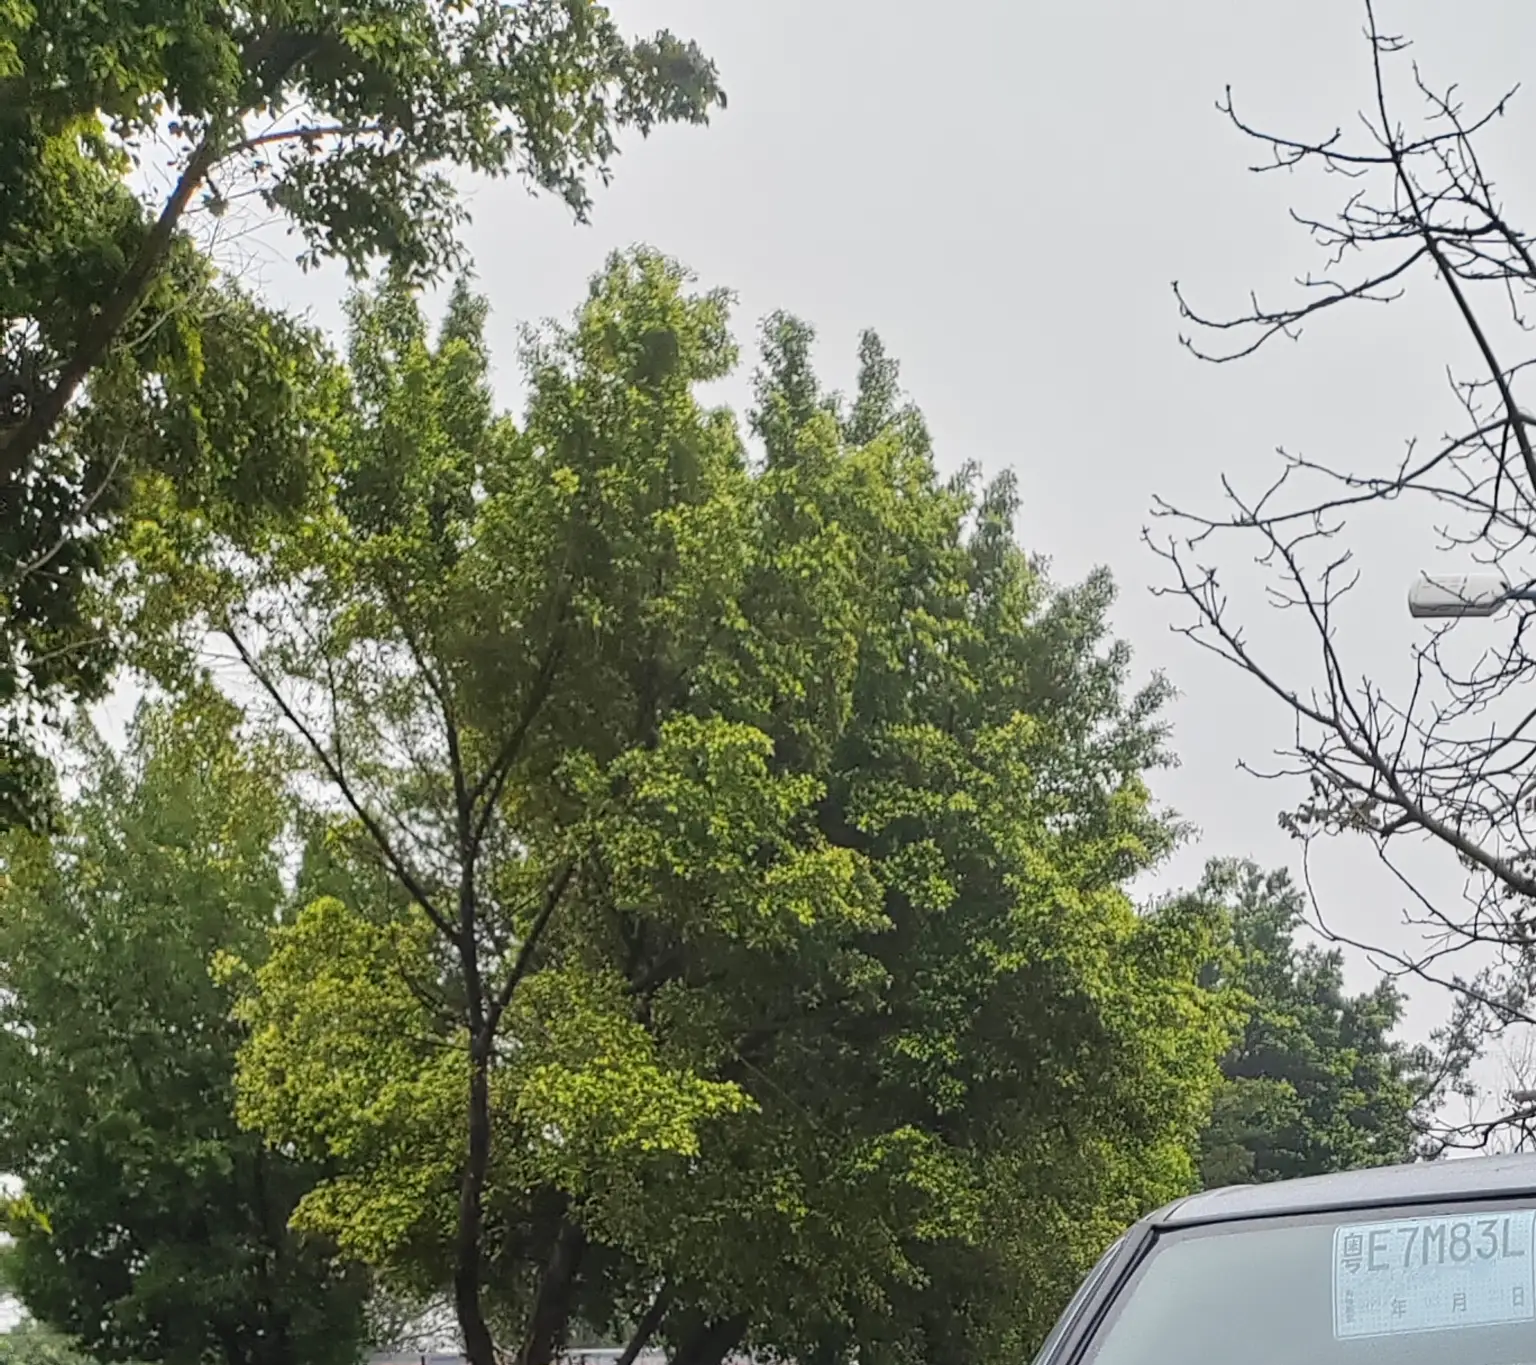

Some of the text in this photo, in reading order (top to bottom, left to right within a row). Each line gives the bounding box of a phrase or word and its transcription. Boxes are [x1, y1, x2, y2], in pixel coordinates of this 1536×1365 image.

[1340, 1218, 1526, 1274] 粤E7M83L
[1391, 1297, 1408, 1319] 年
[1452, 1291, 1468, 1313] 月
[1512, 1285, 1525, 1307] 日
